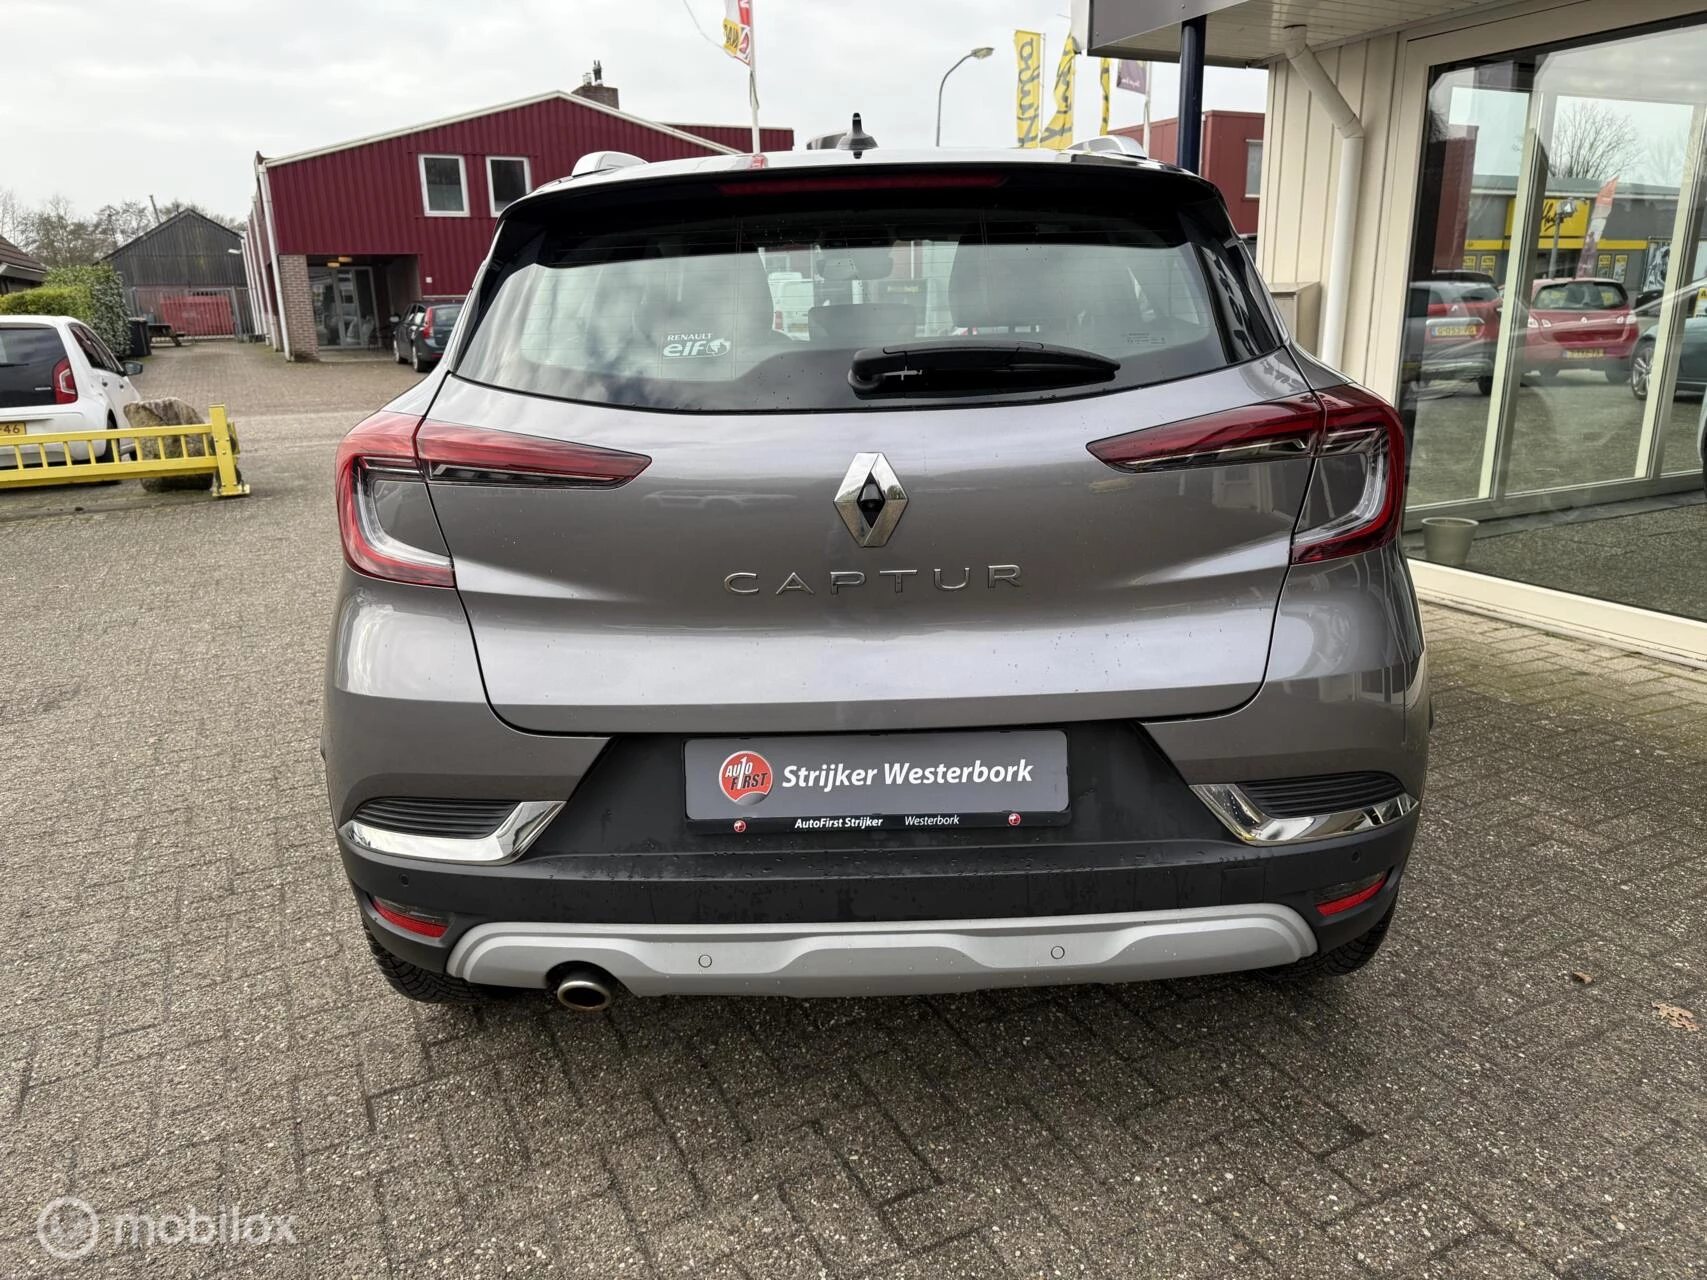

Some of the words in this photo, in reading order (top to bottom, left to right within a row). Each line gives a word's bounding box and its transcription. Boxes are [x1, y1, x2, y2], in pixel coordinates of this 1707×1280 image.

[667, 333, 713, 341] RENAULT
[663, 341, 706, 357] elf
[724, 564, 1023, 595] CAPTUR
[782, 763, 878, 792] Strijker
[884, 759, 1034, 785] Westerbork
[795, 817, 844, 829] AutoFirst
[845, 817, 883, 830] Strijker
[904, 814, 960, 826] Westerbork
